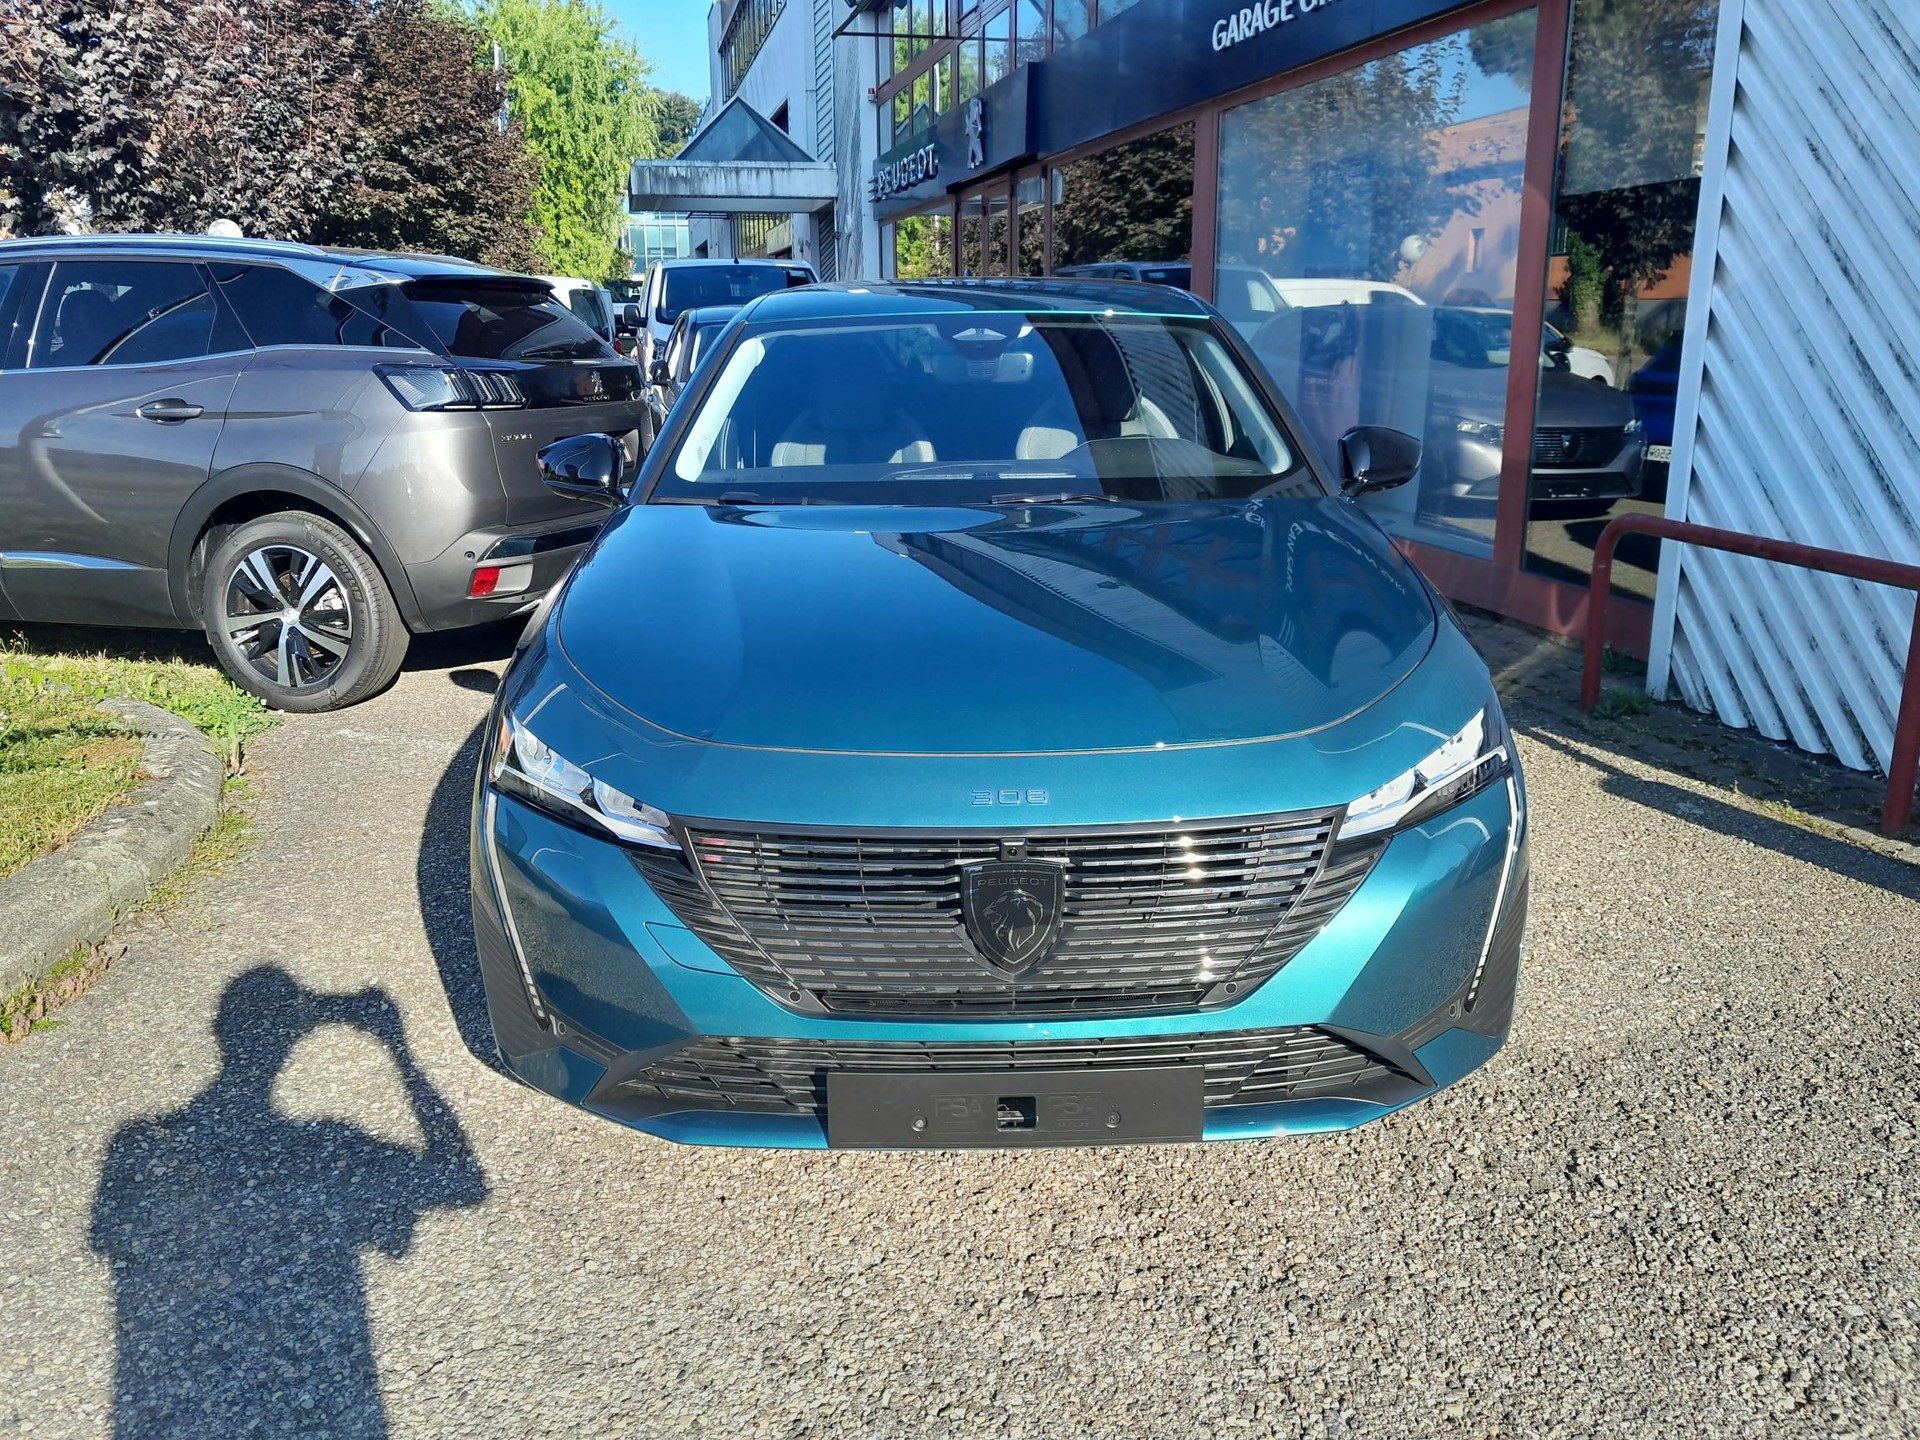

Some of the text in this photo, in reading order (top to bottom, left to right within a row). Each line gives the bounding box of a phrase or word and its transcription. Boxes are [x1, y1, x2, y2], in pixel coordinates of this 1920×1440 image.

[1211, 0, 1295, 51] GARAGE
[869, 143, 938, 202] PEUGEOT
[323, 546, 363, 601] MICHELIN
[971, 789, 1048, 807] 308
[976, 877, 1049, 888] PEUGEOT
